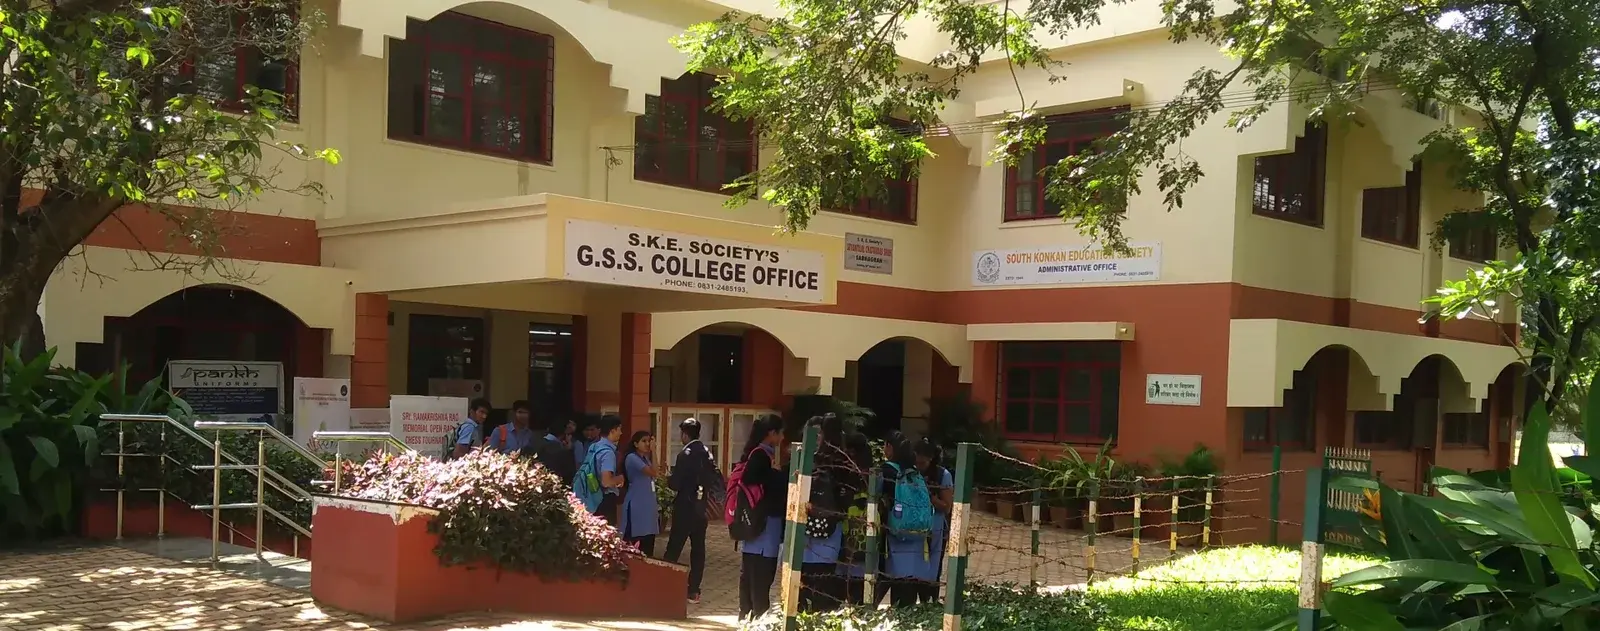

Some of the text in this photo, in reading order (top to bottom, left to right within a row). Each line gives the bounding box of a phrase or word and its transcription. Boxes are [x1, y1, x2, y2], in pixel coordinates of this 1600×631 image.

[628, 232, 780, 263] S.K.E. SOCIETY'S
[1006, 253, 1032, 264] SOUTH
[1034, 251, 1067, 263] KONKAN
[577, 244, 818, 290] G.S.S. COLLEGE OFFICE
[1037, 263, 1117, 273] ADMINISTRATIVE OFFICE
[664, 278, 696, 288] PHONE:
[193, 366, 260, 382] pankh
[403, 424, 429, 433] MEMORIAL
[430, 425, 442, 433] OPEN
[405, 436, 421, 445] CHESS
